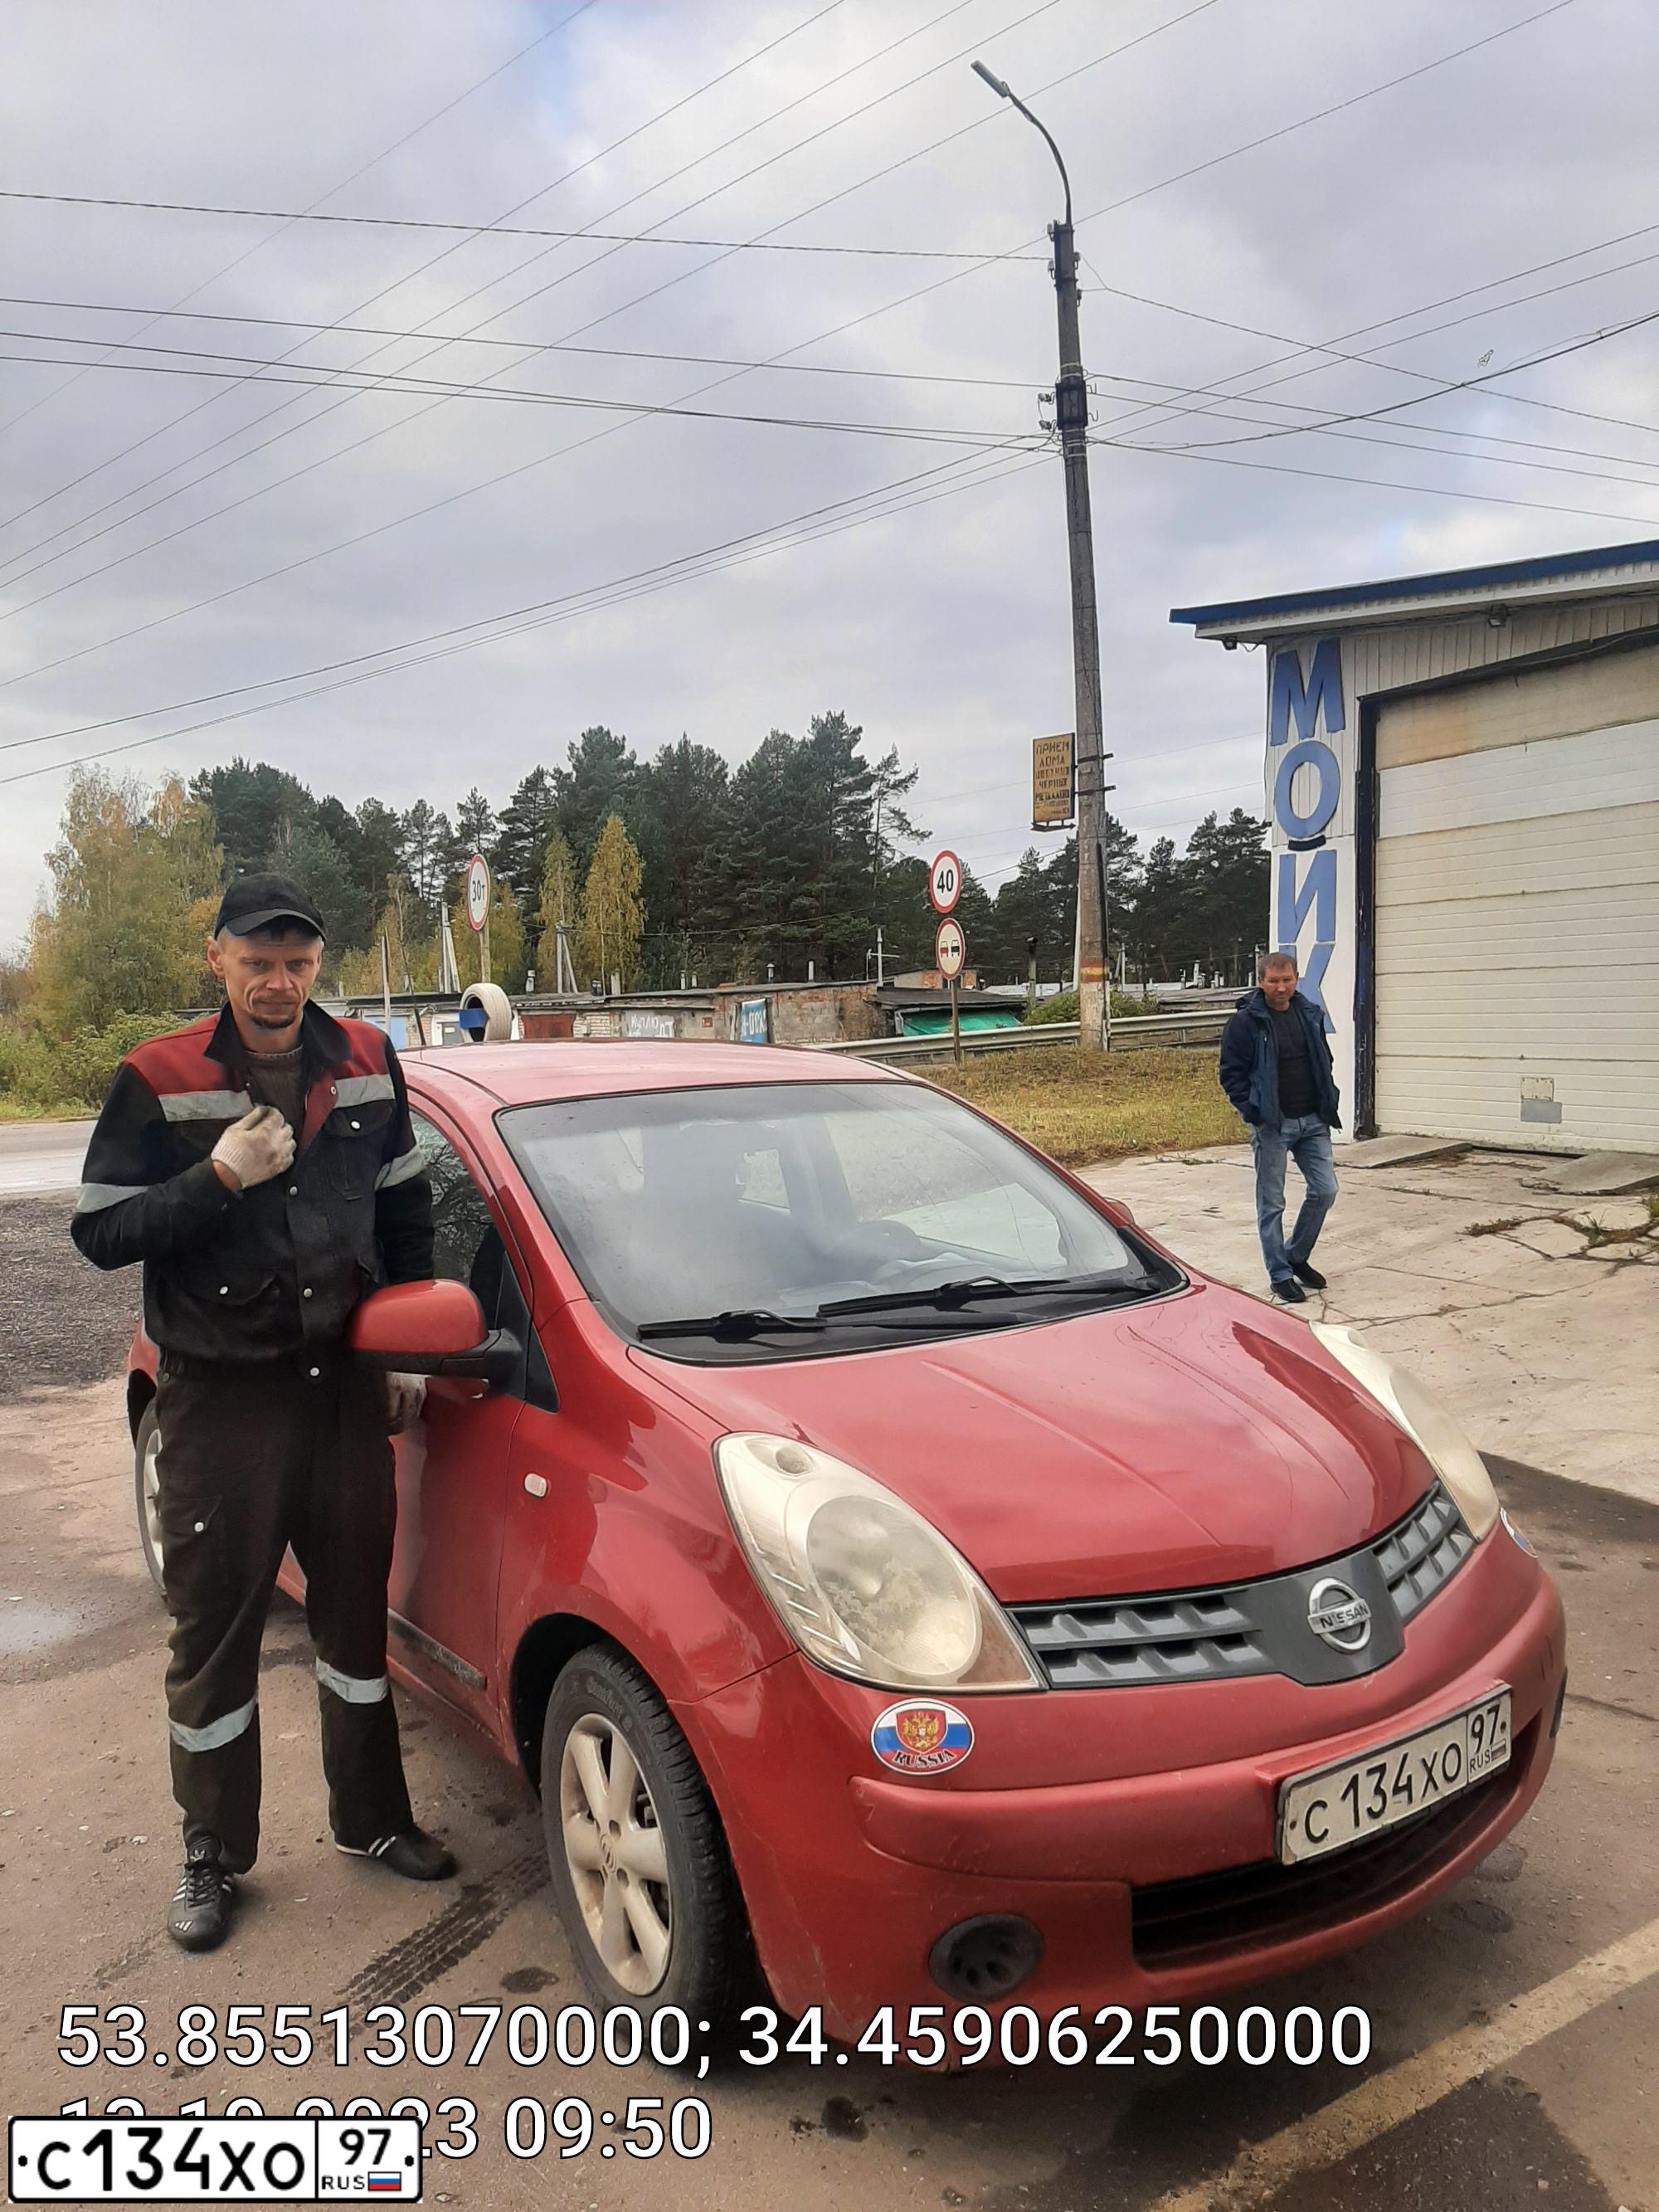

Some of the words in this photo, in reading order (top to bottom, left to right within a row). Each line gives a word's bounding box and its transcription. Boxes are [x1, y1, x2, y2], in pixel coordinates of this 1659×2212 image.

[1039, 755, 1065, 767] ЛОМА
[937, 869, 954, 894] 40
[1320, 1603, 1369, 1629] NISSAN
[1471, 1704, 1500, 1755] 97
[893, 1749, 956, 1767] RUSSIA
[1469, 1749, 1491, 1773] RUS
